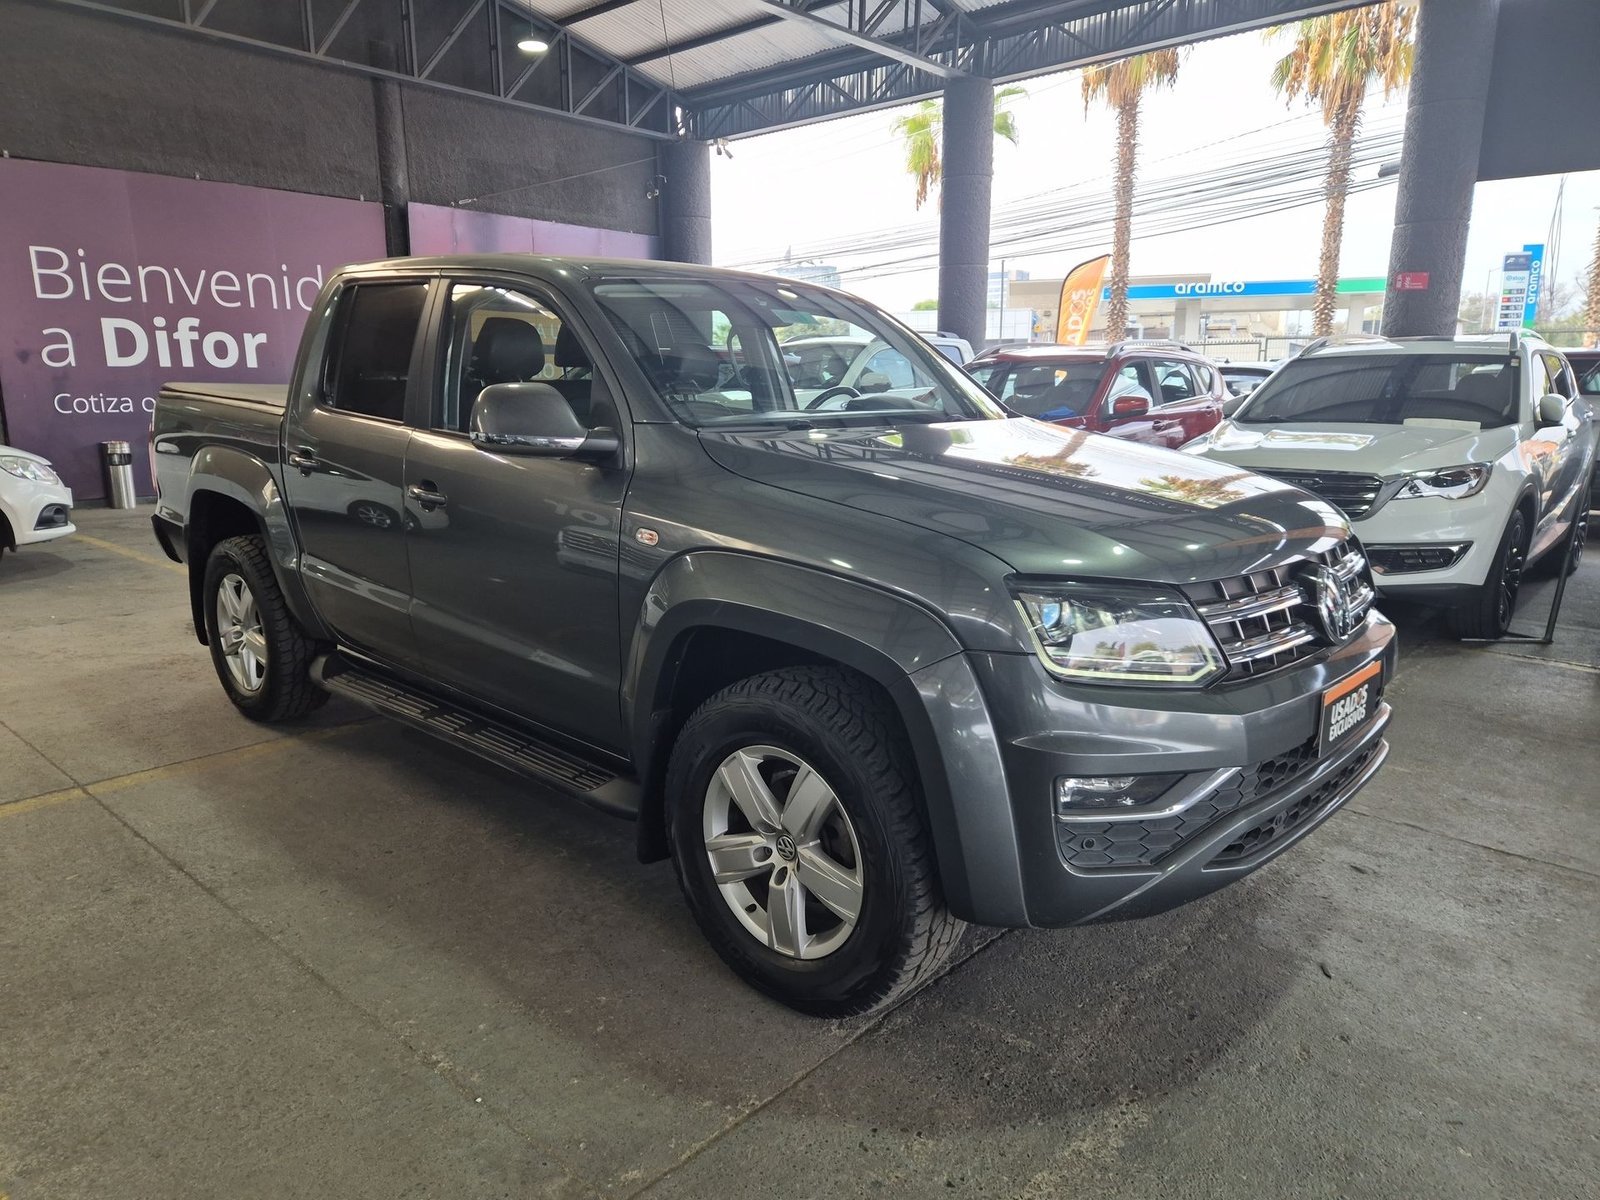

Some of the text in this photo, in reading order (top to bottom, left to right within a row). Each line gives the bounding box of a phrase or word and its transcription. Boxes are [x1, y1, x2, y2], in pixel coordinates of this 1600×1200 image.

[29, 245, 323, 311] Bienvenid
[1175, 281, 1245, 294] aramco
[1528, 260, 1541, 304] aramco
[1067, 289, 1086, 346] ADOS
[41, 316, 267, 369] a Difor
[54, 393, 133, 414] Cotiza
[1329, 704, 1367, 742] EXCLUSIVOS
[1331, 684, 1369, 724] USADOS
